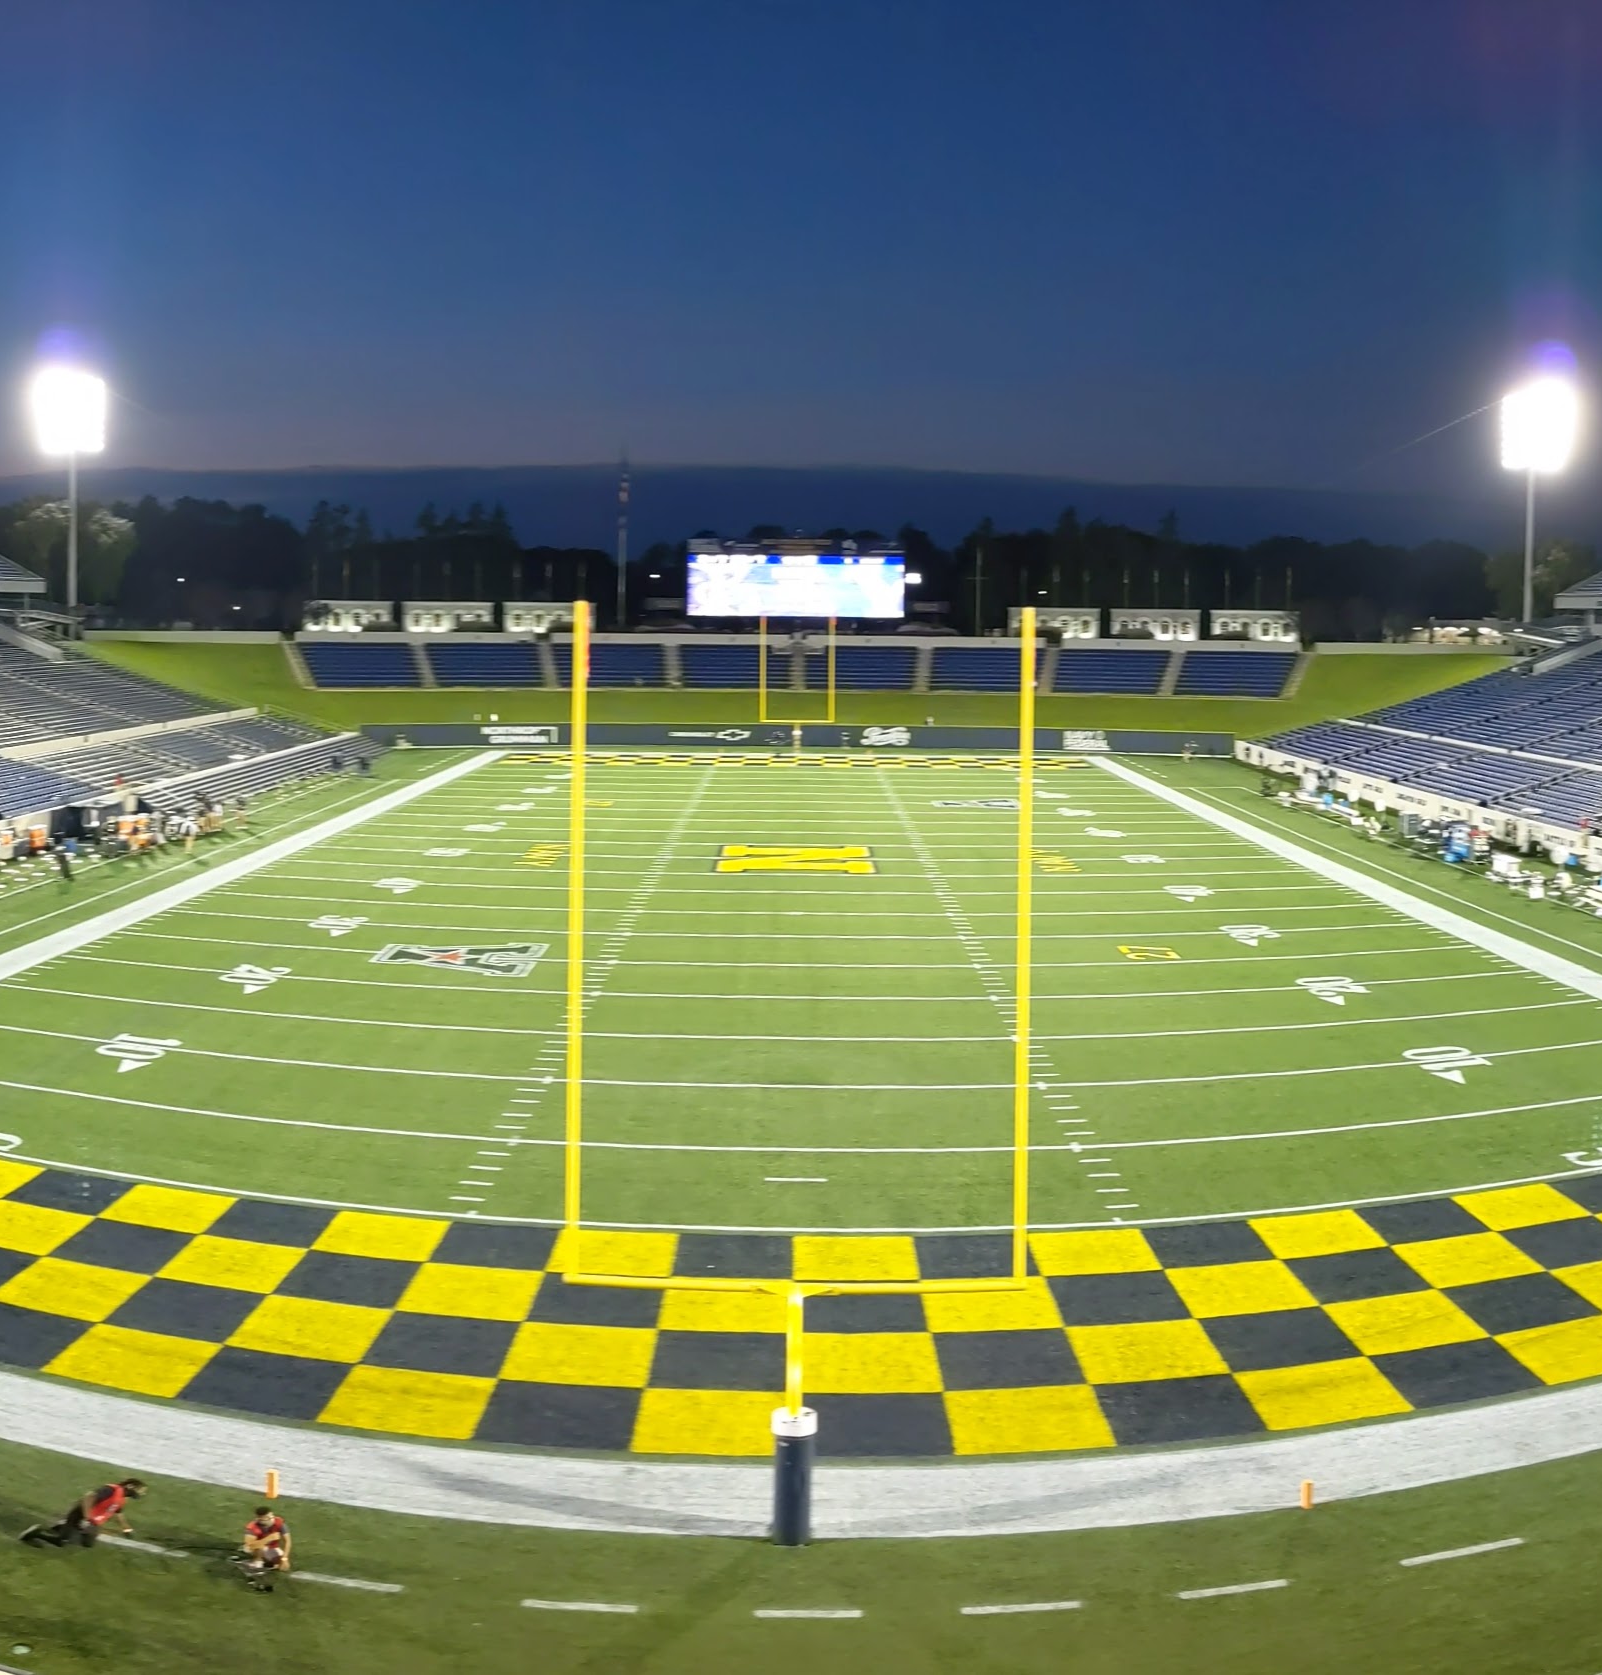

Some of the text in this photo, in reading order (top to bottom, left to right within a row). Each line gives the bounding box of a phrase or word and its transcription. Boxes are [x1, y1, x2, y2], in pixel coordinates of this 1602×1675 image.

[714, 844, 878, 875] N
[307, 914, 370, 931] 30
[1218, 924, 1282, 940] 30
[218, 963, 293, 985] 20
[1294, 976, 1373, 997] 20
[94, 1033, 184, 1060] 10
[1401, 1046, 1493, 1071] 10
